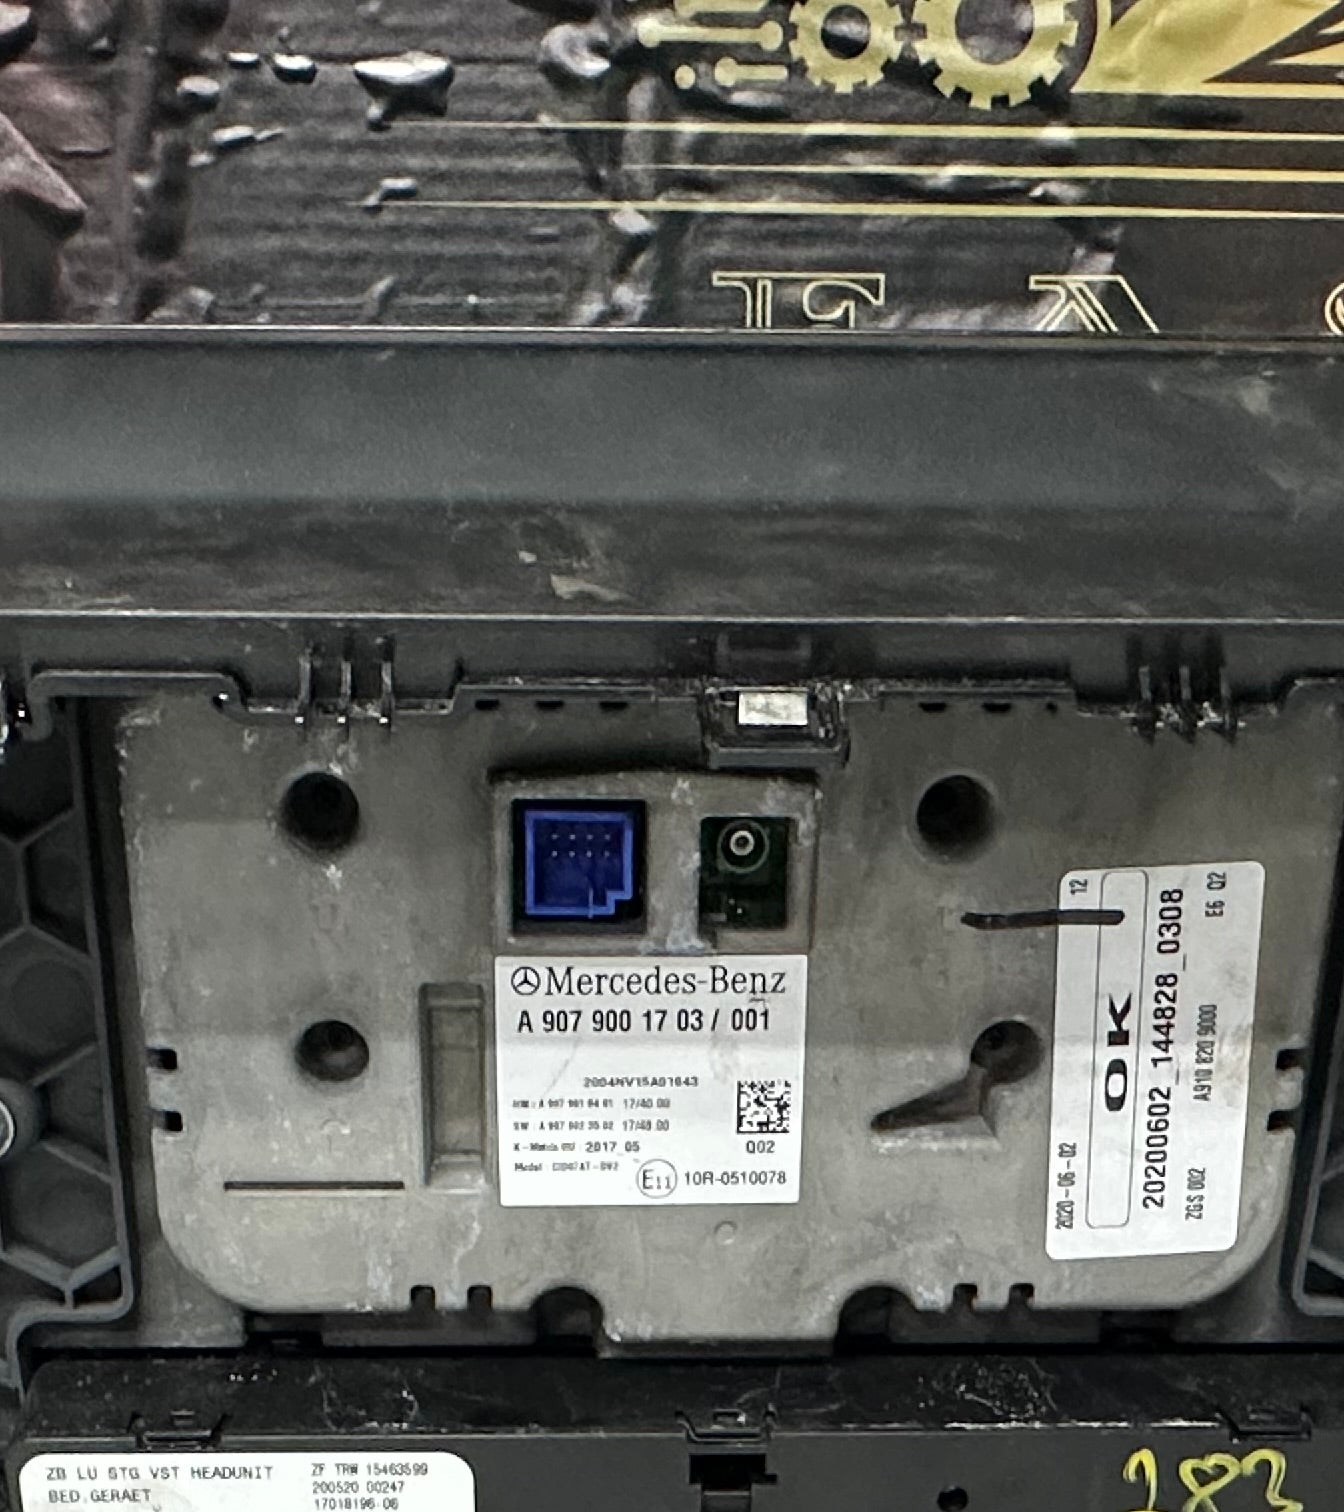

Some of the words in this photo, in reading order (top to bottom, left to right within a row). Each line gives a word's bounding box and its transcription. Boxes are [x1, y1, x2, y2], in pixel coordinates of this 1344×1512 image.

[1070, 879, 1088, 895] 12
[546, 966, 786, 996] Mercedes-Benz
[518, 1010, 533, 1033] A
[542, 1010, 582, 1033] 907
[592, 1010, 631, 1032] 900
[642, 1009, 668, 1032] 17
[731, 1009, 770, 1031] 001
[684, 1172, 787, 1186] 10R-0510078
[77, 1467, 97, 1480] LU
[150, 1466, 180, 1479] VST
[191, 1466, 273, 1479] HEADUNIT
[311, 1463, 329, 1476] ZF
[312, 1481, 359, 1493] 200520
